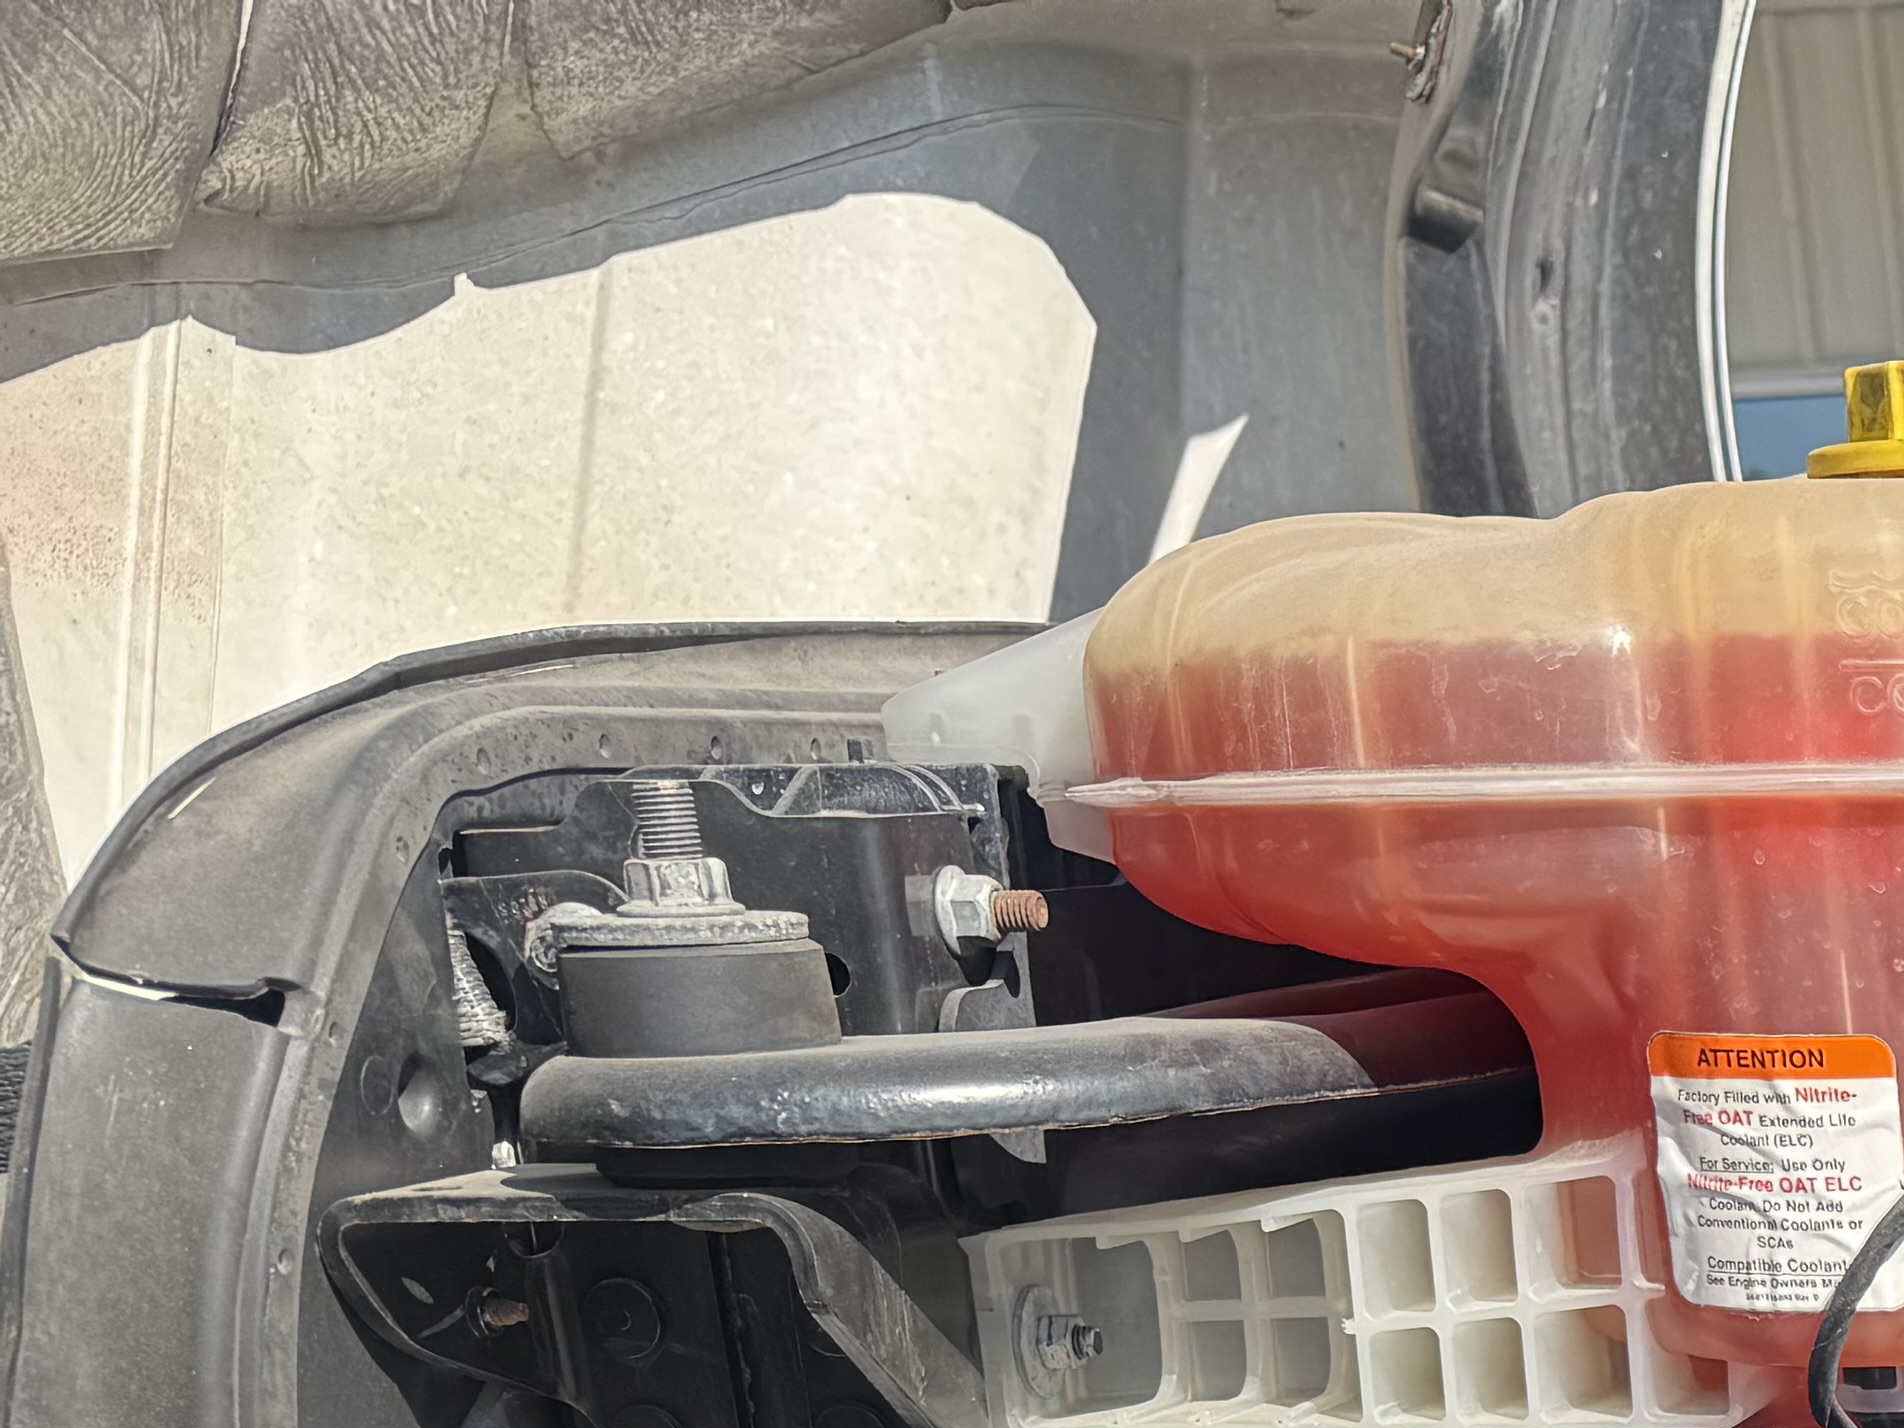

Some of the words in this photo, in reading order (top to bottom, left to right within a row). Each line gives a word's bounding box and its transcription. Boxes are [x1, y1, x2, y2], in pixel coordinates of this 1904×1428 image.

[1697, 1048, 1824, 1068] ATTENTION
[1678, 1089, 1720, 1105] Factory
[1725, 1092, 1759, 1104] Filled
[1764, 1093, 1791, 1104] with
[1796, 1087, 1857, 1102] Nitrite-
[1684, 1112, 1713, 1124] Free
[1718, 1111, 1753, 1125] OAT
[1759, 1115, 1823, 1128] Extended
[1829, 1114, 1855, 1127] Life
[1721, 1134, 1769, 1146] Coolant
[1774, 1134, 1813, 1148] (ELC)
[1700, 1158, 1718, 1170] For
[1723, 1159, 1774, 1171] Service:
[1782, 1159, 1807, 1171] Use
[1813, 1158, 1845, 1173] Only
[1688, 1174, 1774, 1192] Nitrite-Free
[1780, 1177, 1818, 1193] OAT
[1826, 1177, 1862, 1192] ELC
[1763, 1200, 1781, 1211] Do
[1786, 1200, 1810, 1211] Not
[1816, 1200, 1843, 1212] Add
[1698, 1216, 1777, 1229] Conventional
[1781, 1217, 1843, 1230] Coolants
[1848, 1219, 1862, 1230] or
[1757, 1236, 1793, 1249] SCAs
[1708, 1257, 1782, 1274] Compatible
[1707, 1275, 1725, 1286] See
[1729, 1277, 1767, 1290] Engine
